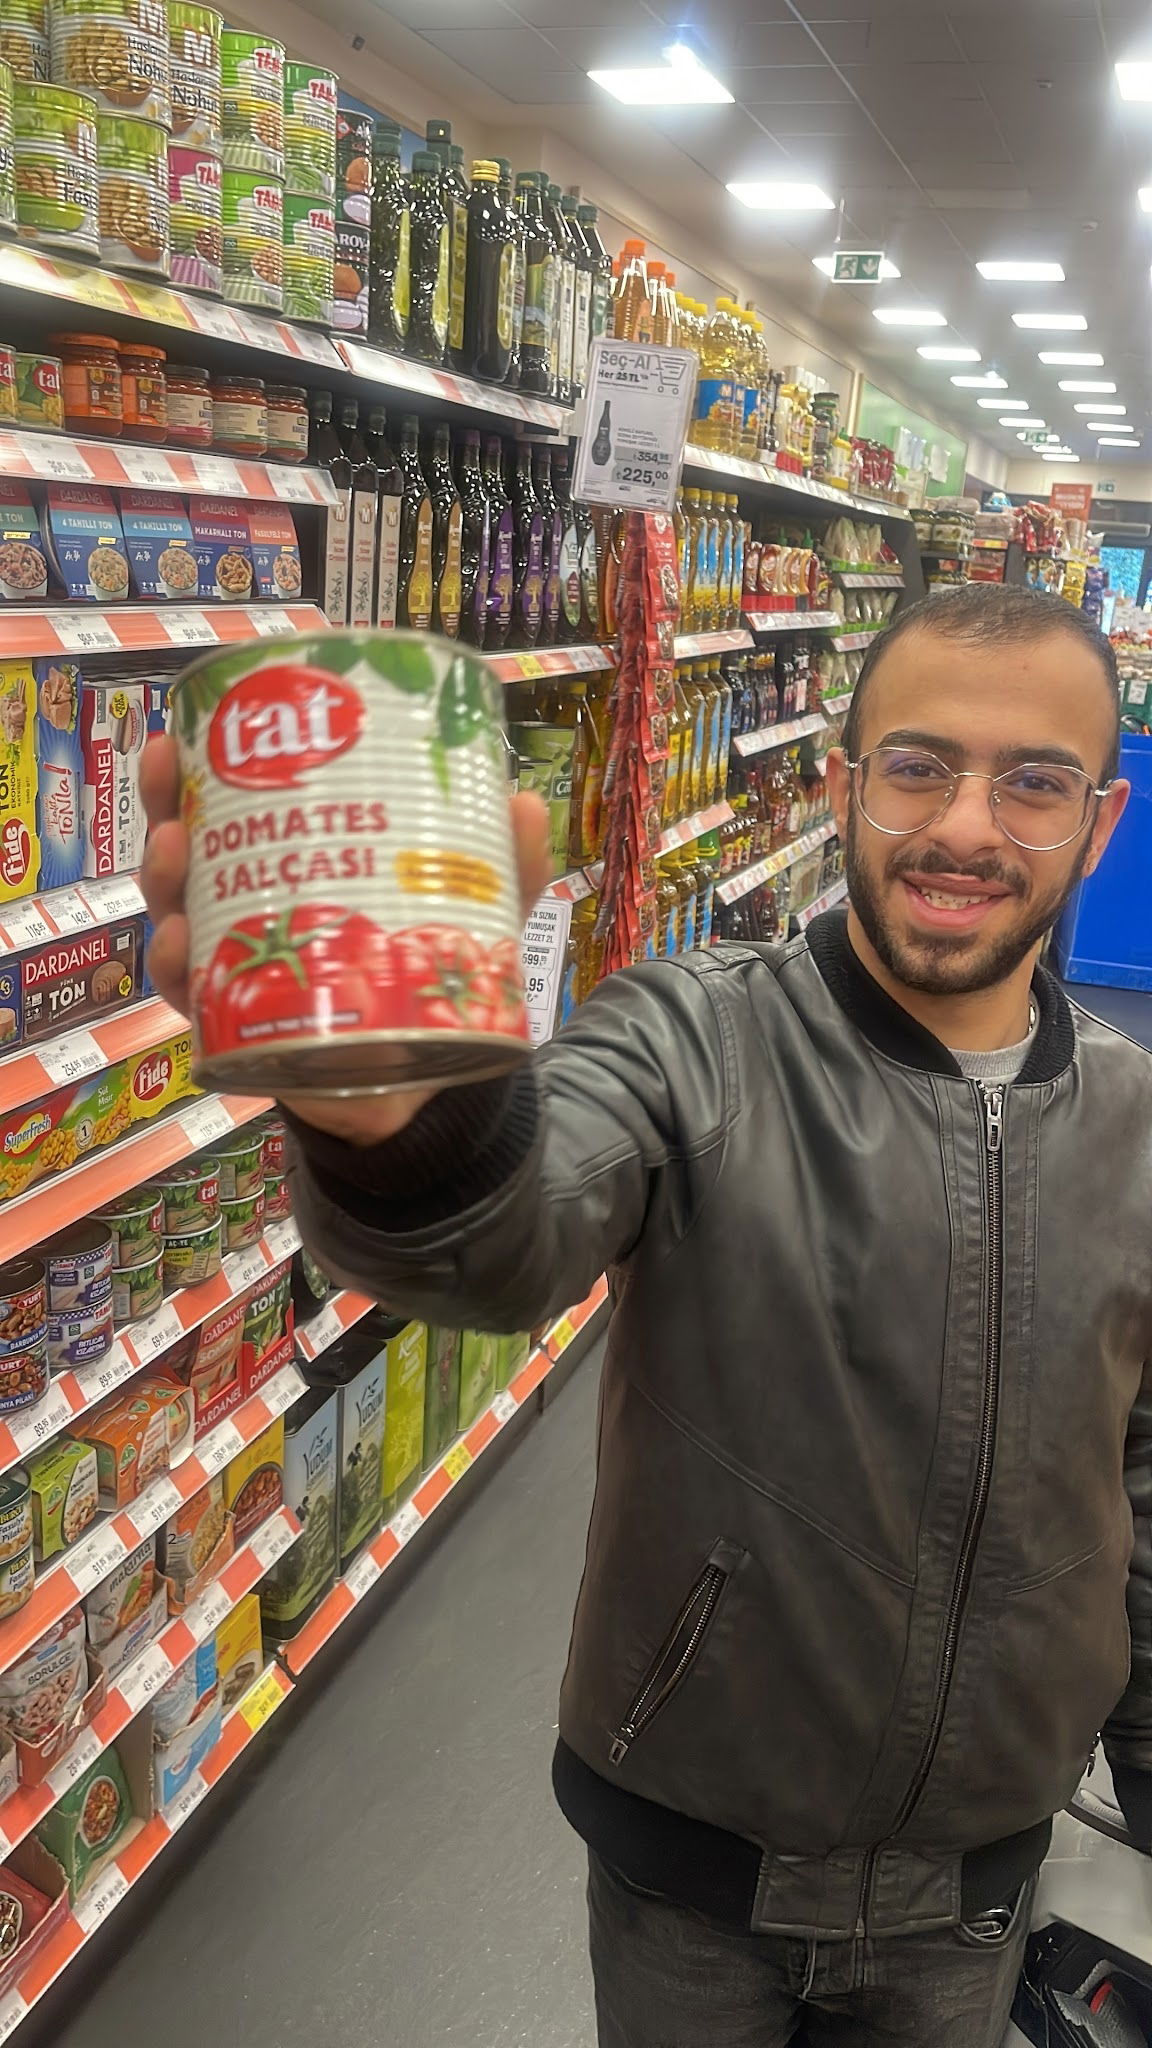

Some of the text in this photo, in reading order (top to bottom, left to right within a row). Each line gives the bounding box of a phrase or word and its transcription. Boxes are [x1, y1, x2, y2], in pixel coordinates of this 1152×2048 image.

[221, 684, 346, 769] tat
[98, 743, 113, 873] DARDANEL
[119, 777, 131, 830] TON
[4, 826, 24, 876] Fide
[204, 802, 389, 860] DOMATES
[214, 846, 377, 901] SALÇASI
[527, 921, 556, 934] YUMUŞAK
[25, 938, 108, 985] DARDANEL
[48, 980, 86, 1011] TON
[138, 1058, 169, 1095] Fide
[22, 1291, 43, 1306] YURT
[250, 1290, 277, 1318] TON
[249, 1343, 293, 1390] DARDANEL
[193, 1385, 243, 1436] DARDANEL
[167, 1533, 177, 1545] 2
